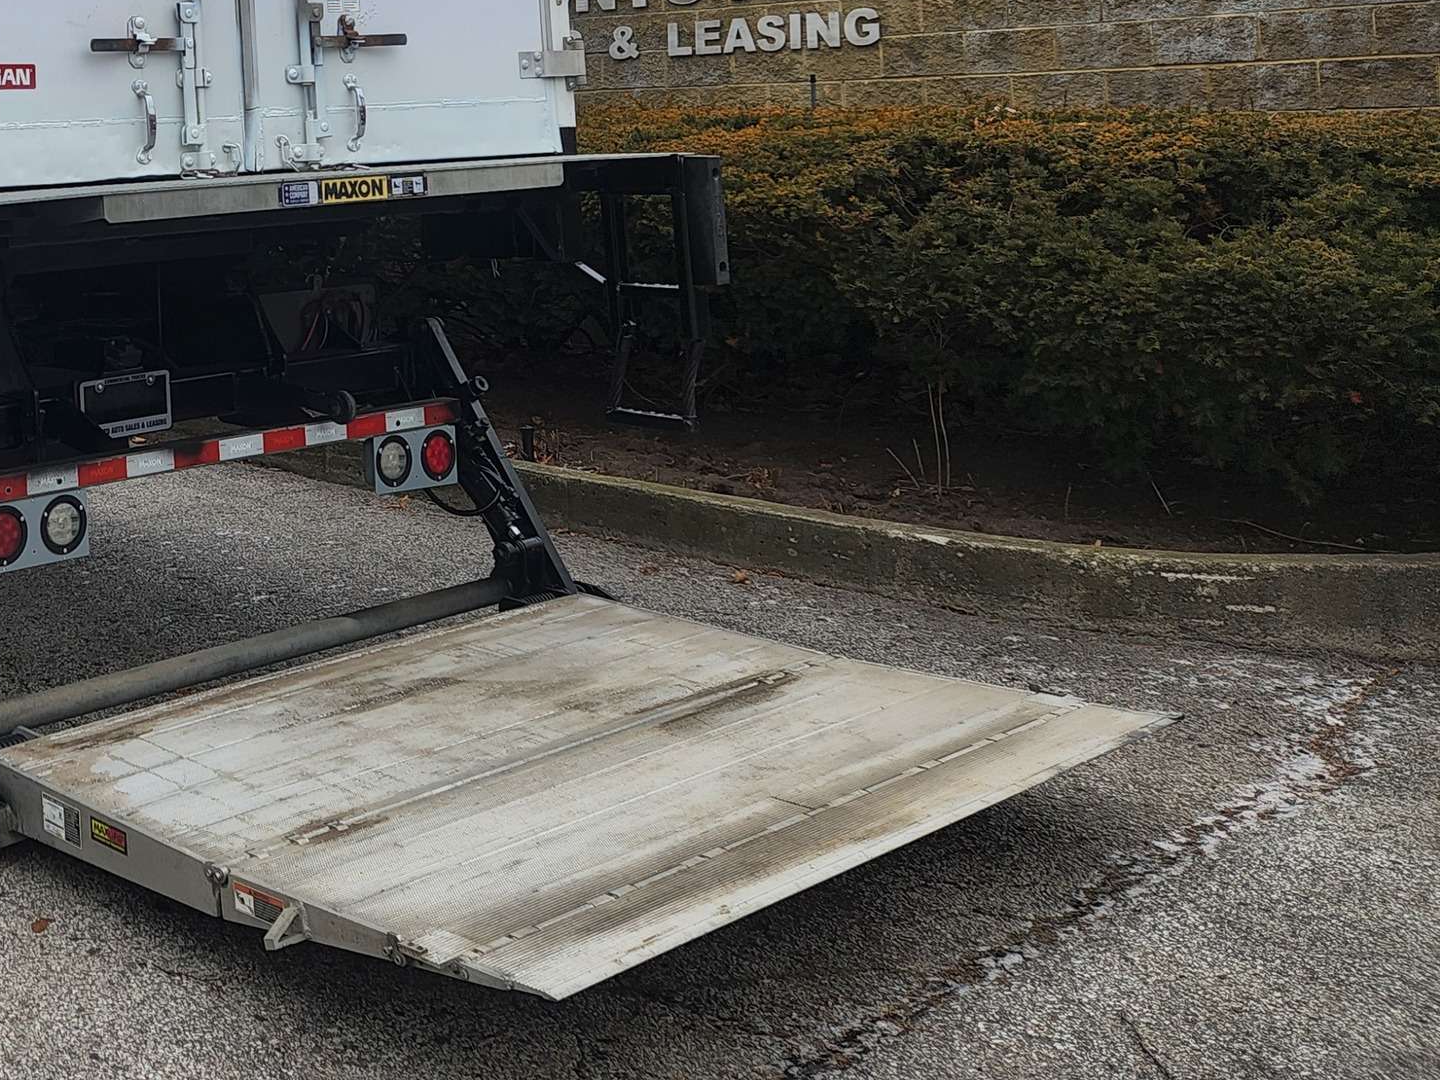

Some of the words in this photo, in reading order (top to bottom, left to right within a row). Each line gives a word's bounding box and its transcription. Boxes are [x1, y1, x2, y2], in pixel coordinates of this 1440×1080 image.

[608, 25, 640, 61] &
[667, 7, 881, 57] LEASING
[324, 178, 385, 201] MAXON
